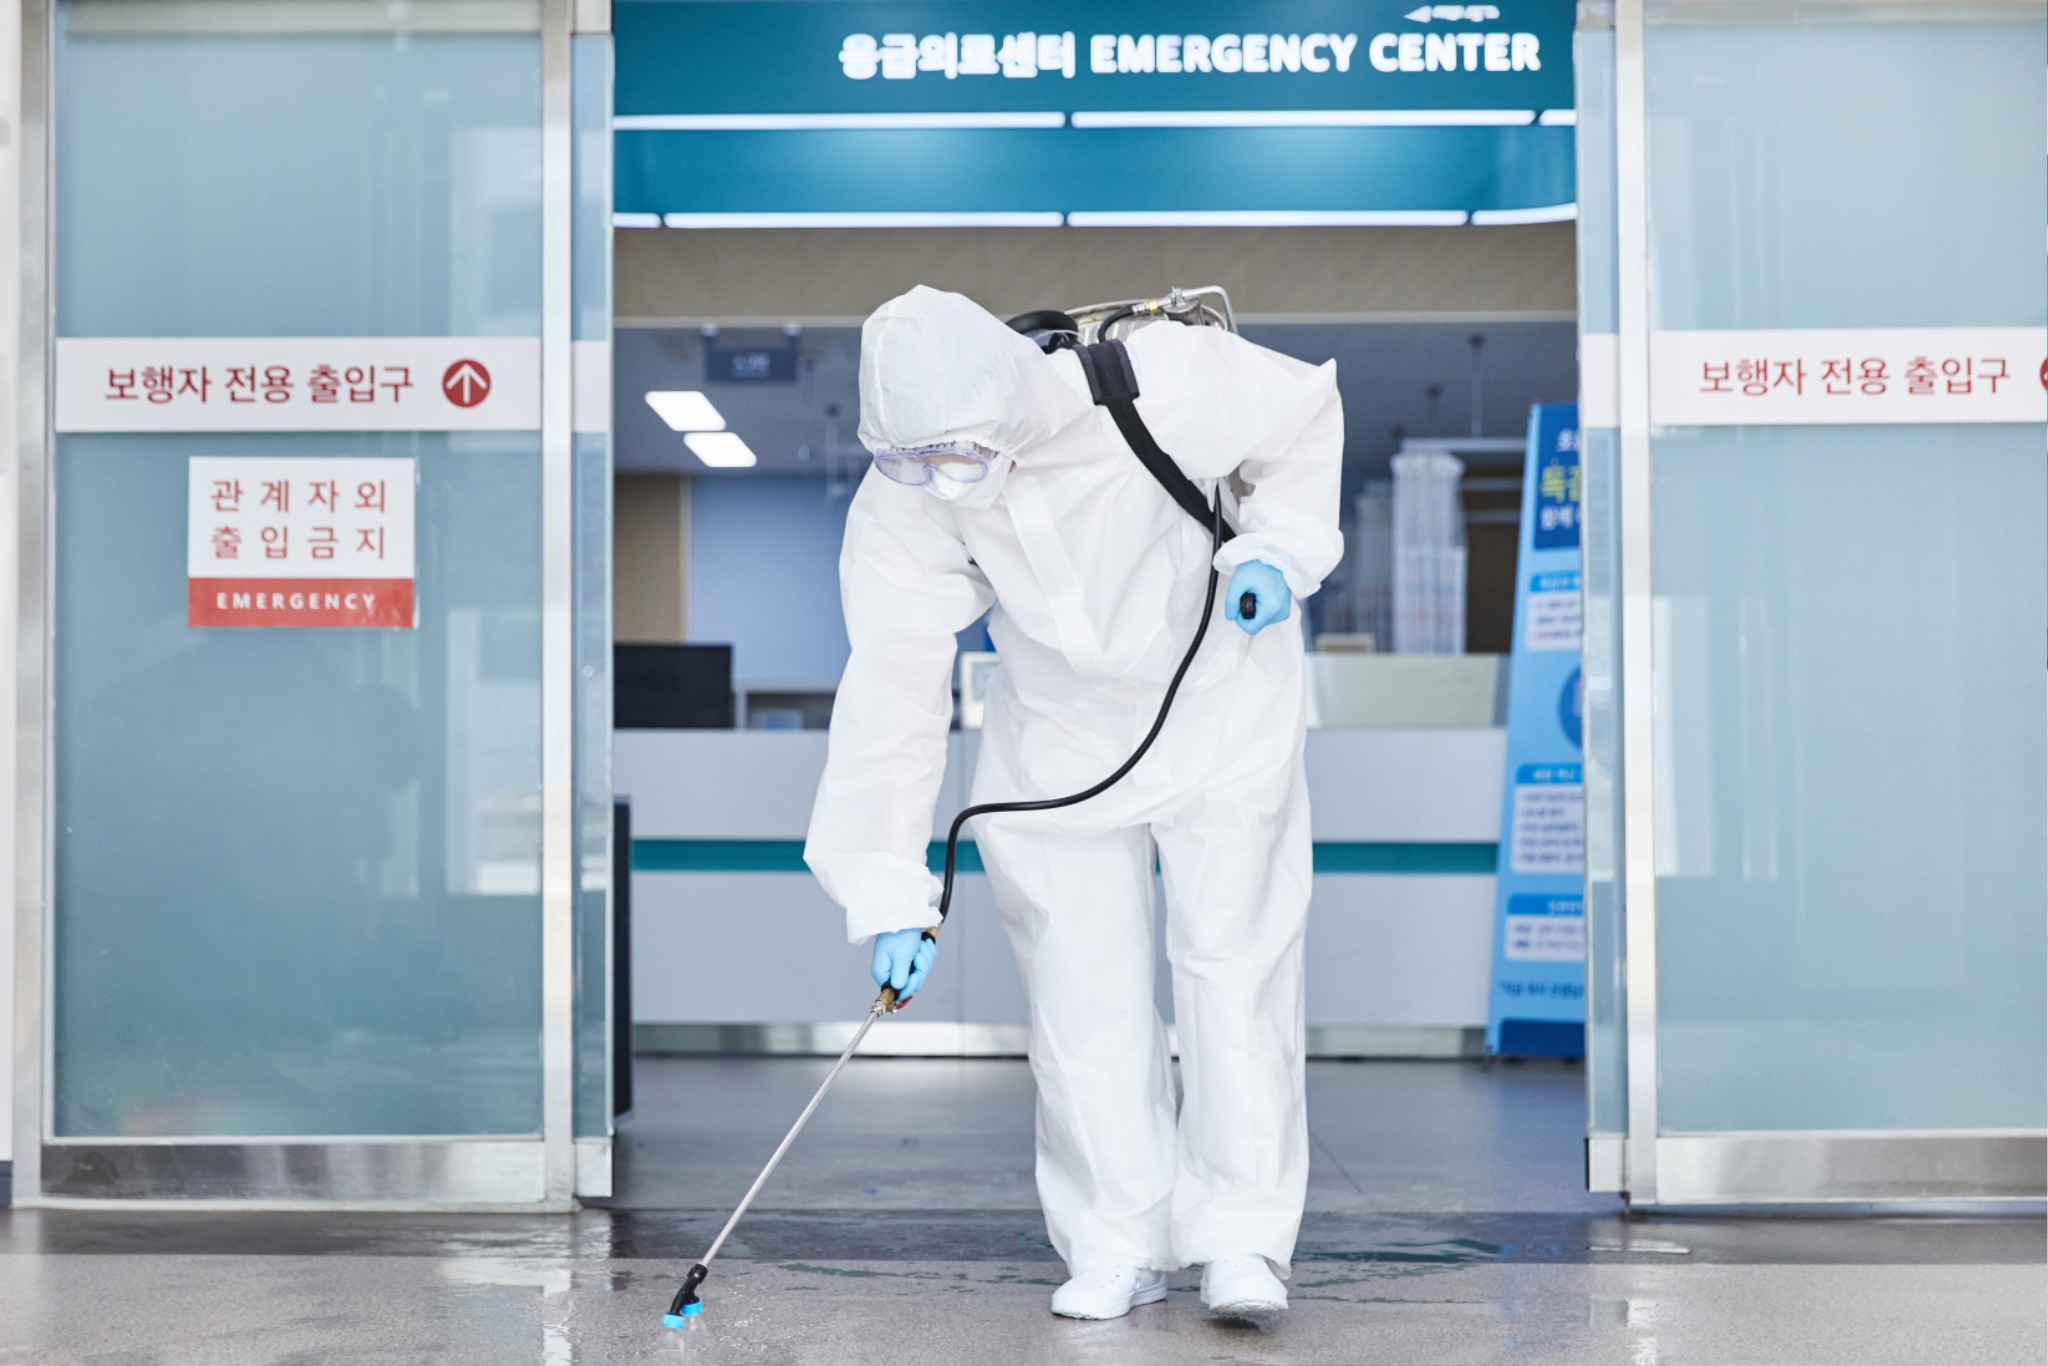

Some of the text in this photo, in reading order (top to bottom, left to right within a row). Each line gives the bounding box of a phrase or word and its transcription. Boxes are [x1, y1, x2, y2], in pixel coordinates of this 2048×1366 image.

[839, 32, 1540, 79] 응급의료센터 EMERGENCY CENTER
[105, 364, 414, 404] 보행자 전용 출입구
[1700, 356, 2011, 396] 보행자 전용 출입구
[216, 593, 376, 610] EMERGENCY
